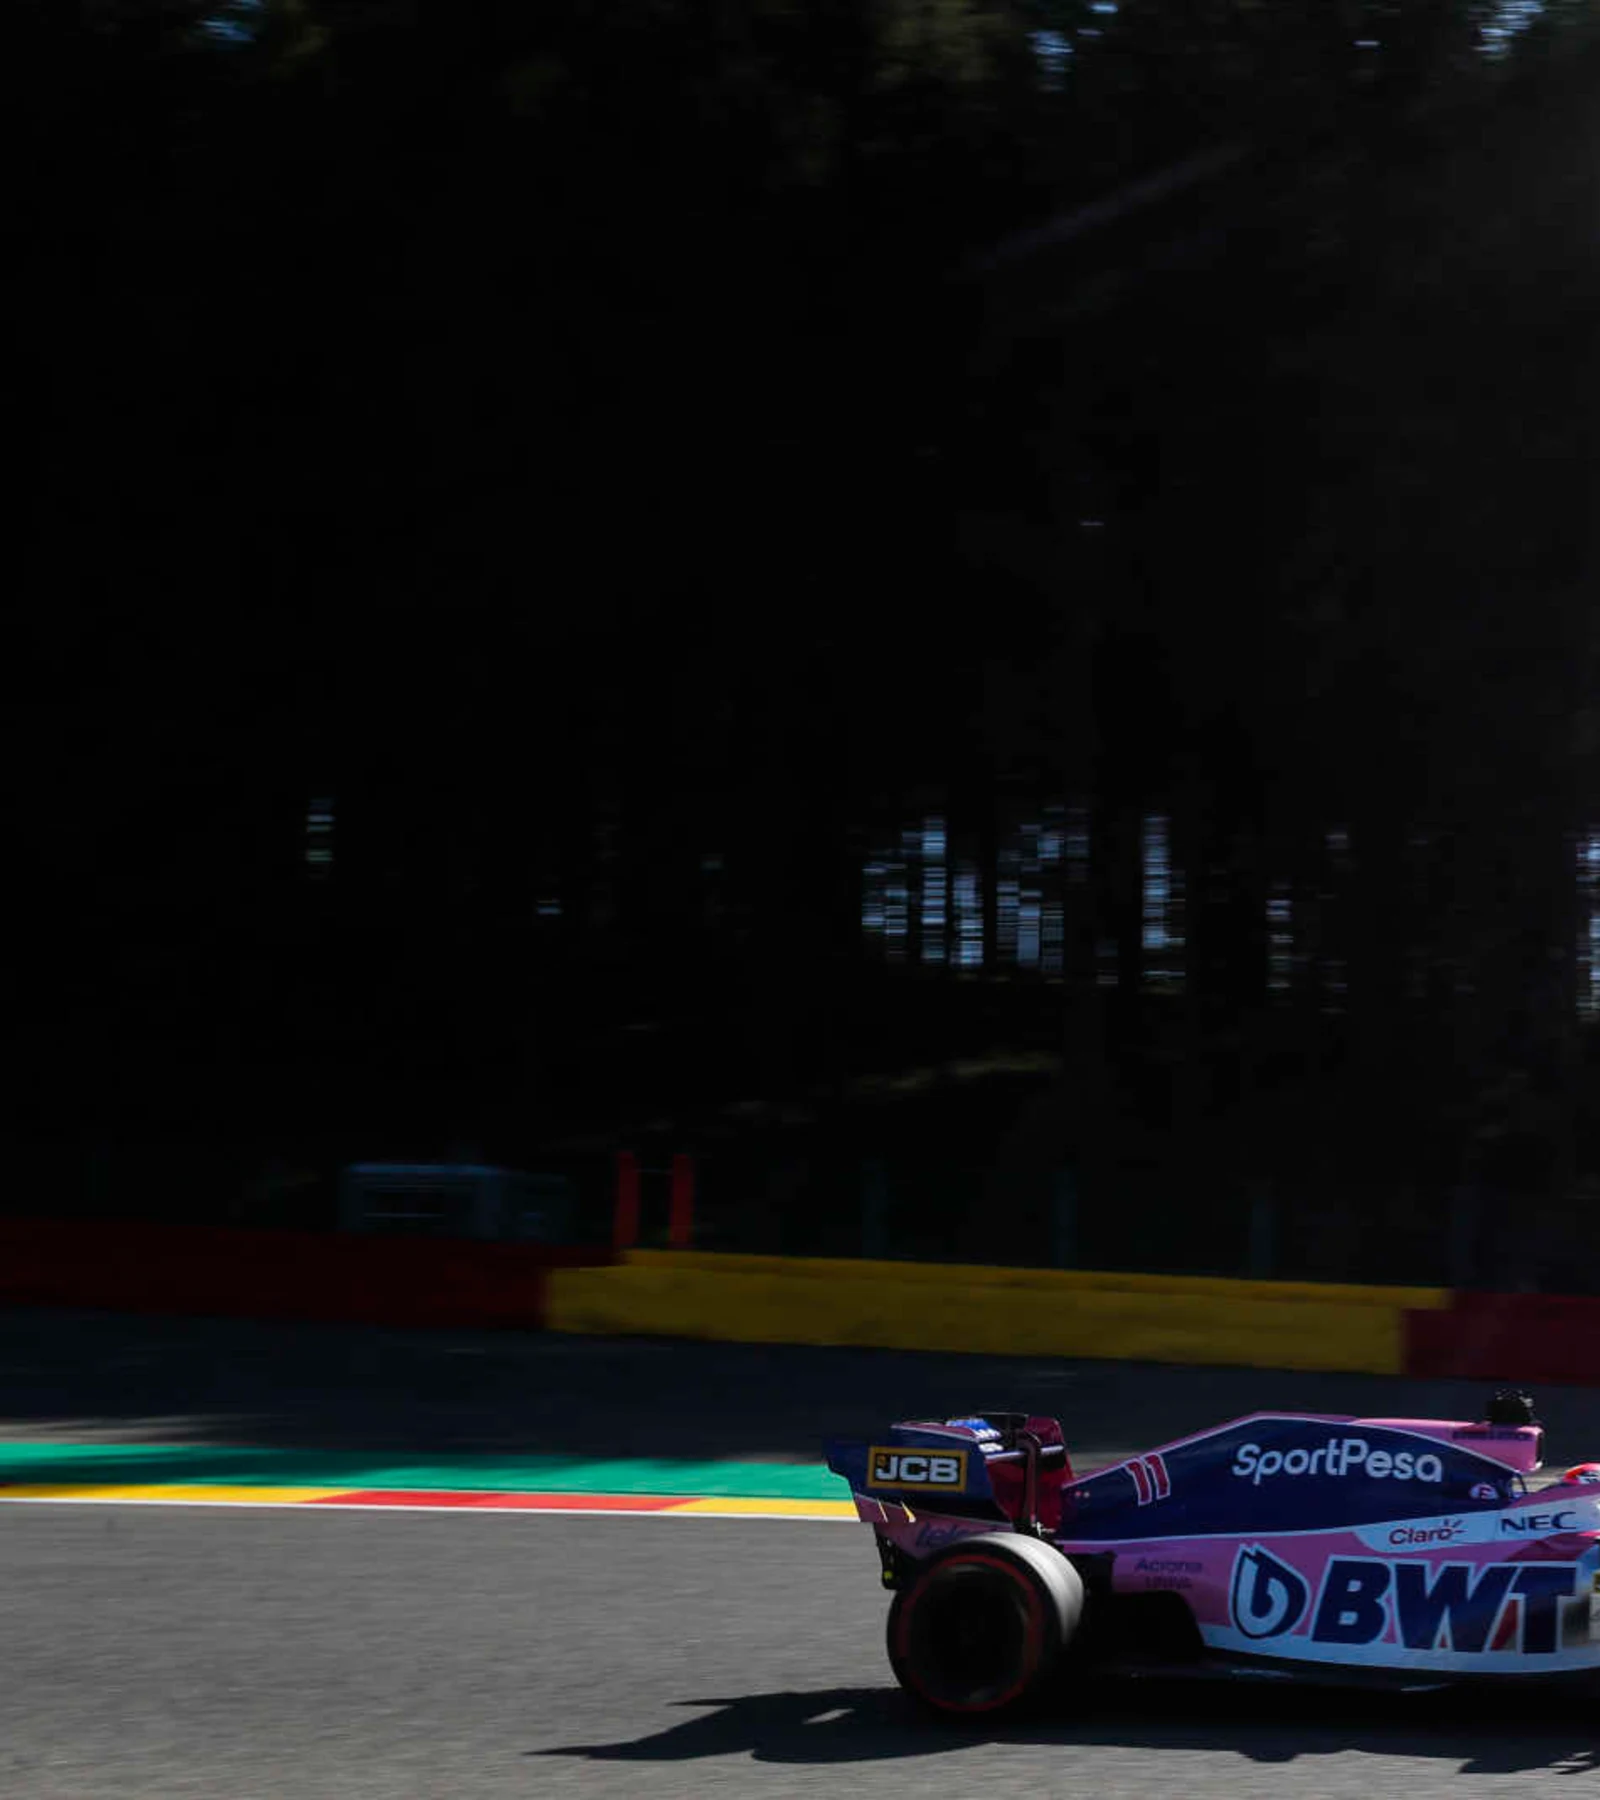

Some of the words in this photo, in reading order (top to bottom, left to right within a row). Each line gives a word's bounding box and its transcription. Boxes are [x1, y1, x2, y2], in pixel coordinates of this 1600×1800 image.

[875, 1455, 958, 1483] JCB
[1124, 1453, 1171, 1506] 11
[1232, 1439, 1443, 1485] SportPesa
[1389, 1525, 1453, 1546] Claro
[1501, 1512, 1576, 1531] NEC
[1312, 1557, 1577, 1655] BWT
